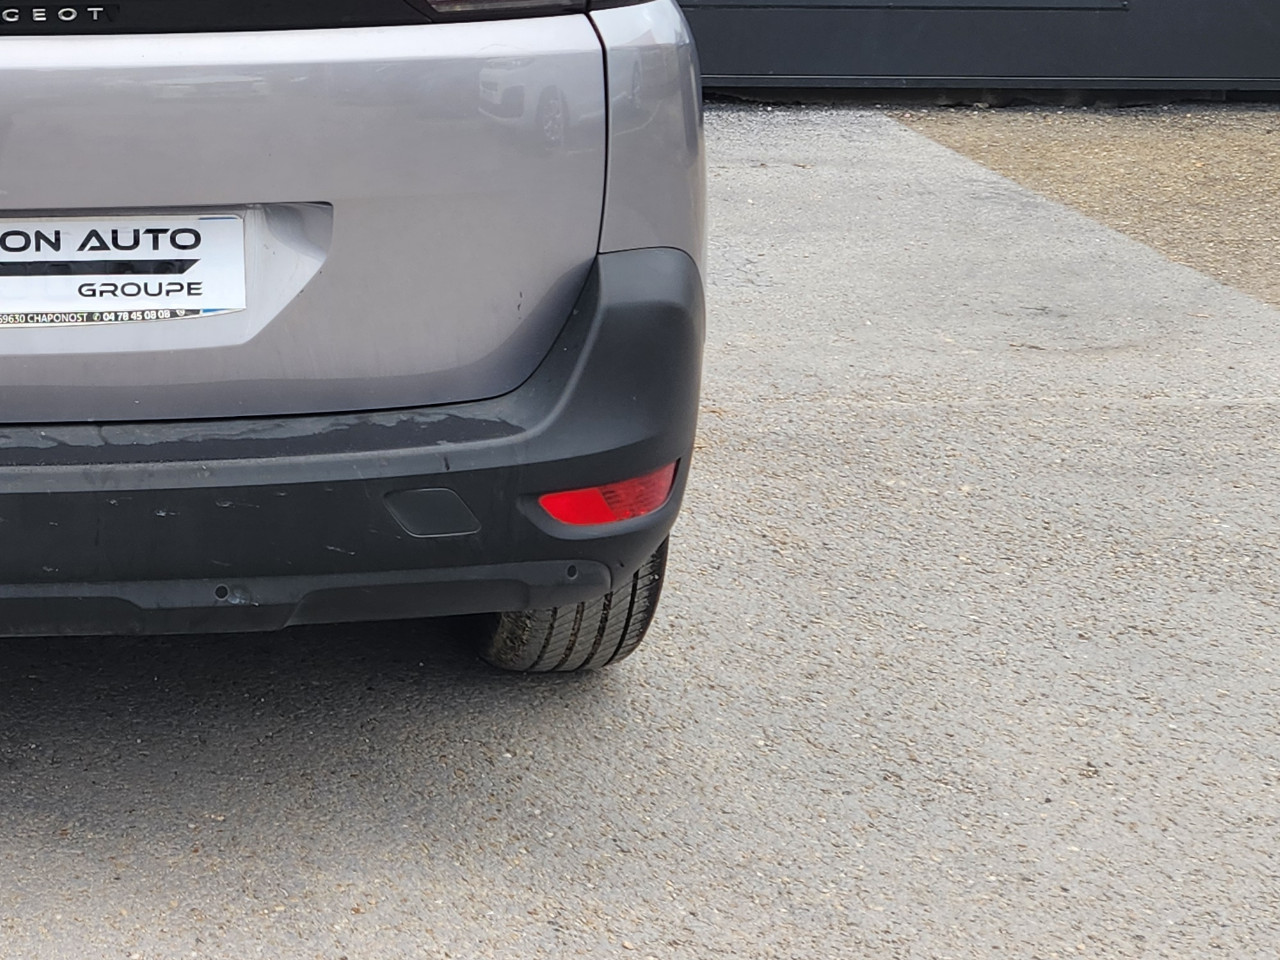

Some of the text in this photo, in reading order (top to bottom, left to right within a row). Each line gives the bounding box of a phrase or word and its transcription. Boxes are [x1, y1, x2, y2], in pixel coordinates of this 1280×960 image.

[77, 228, 202, 252] AUTO
[77, 281, 204, 298] GROUPE
[27, 312, 88, 323] CHAPONOST
[102, 312, 115, 321] 04
[130, 311, 143, 320] 45
